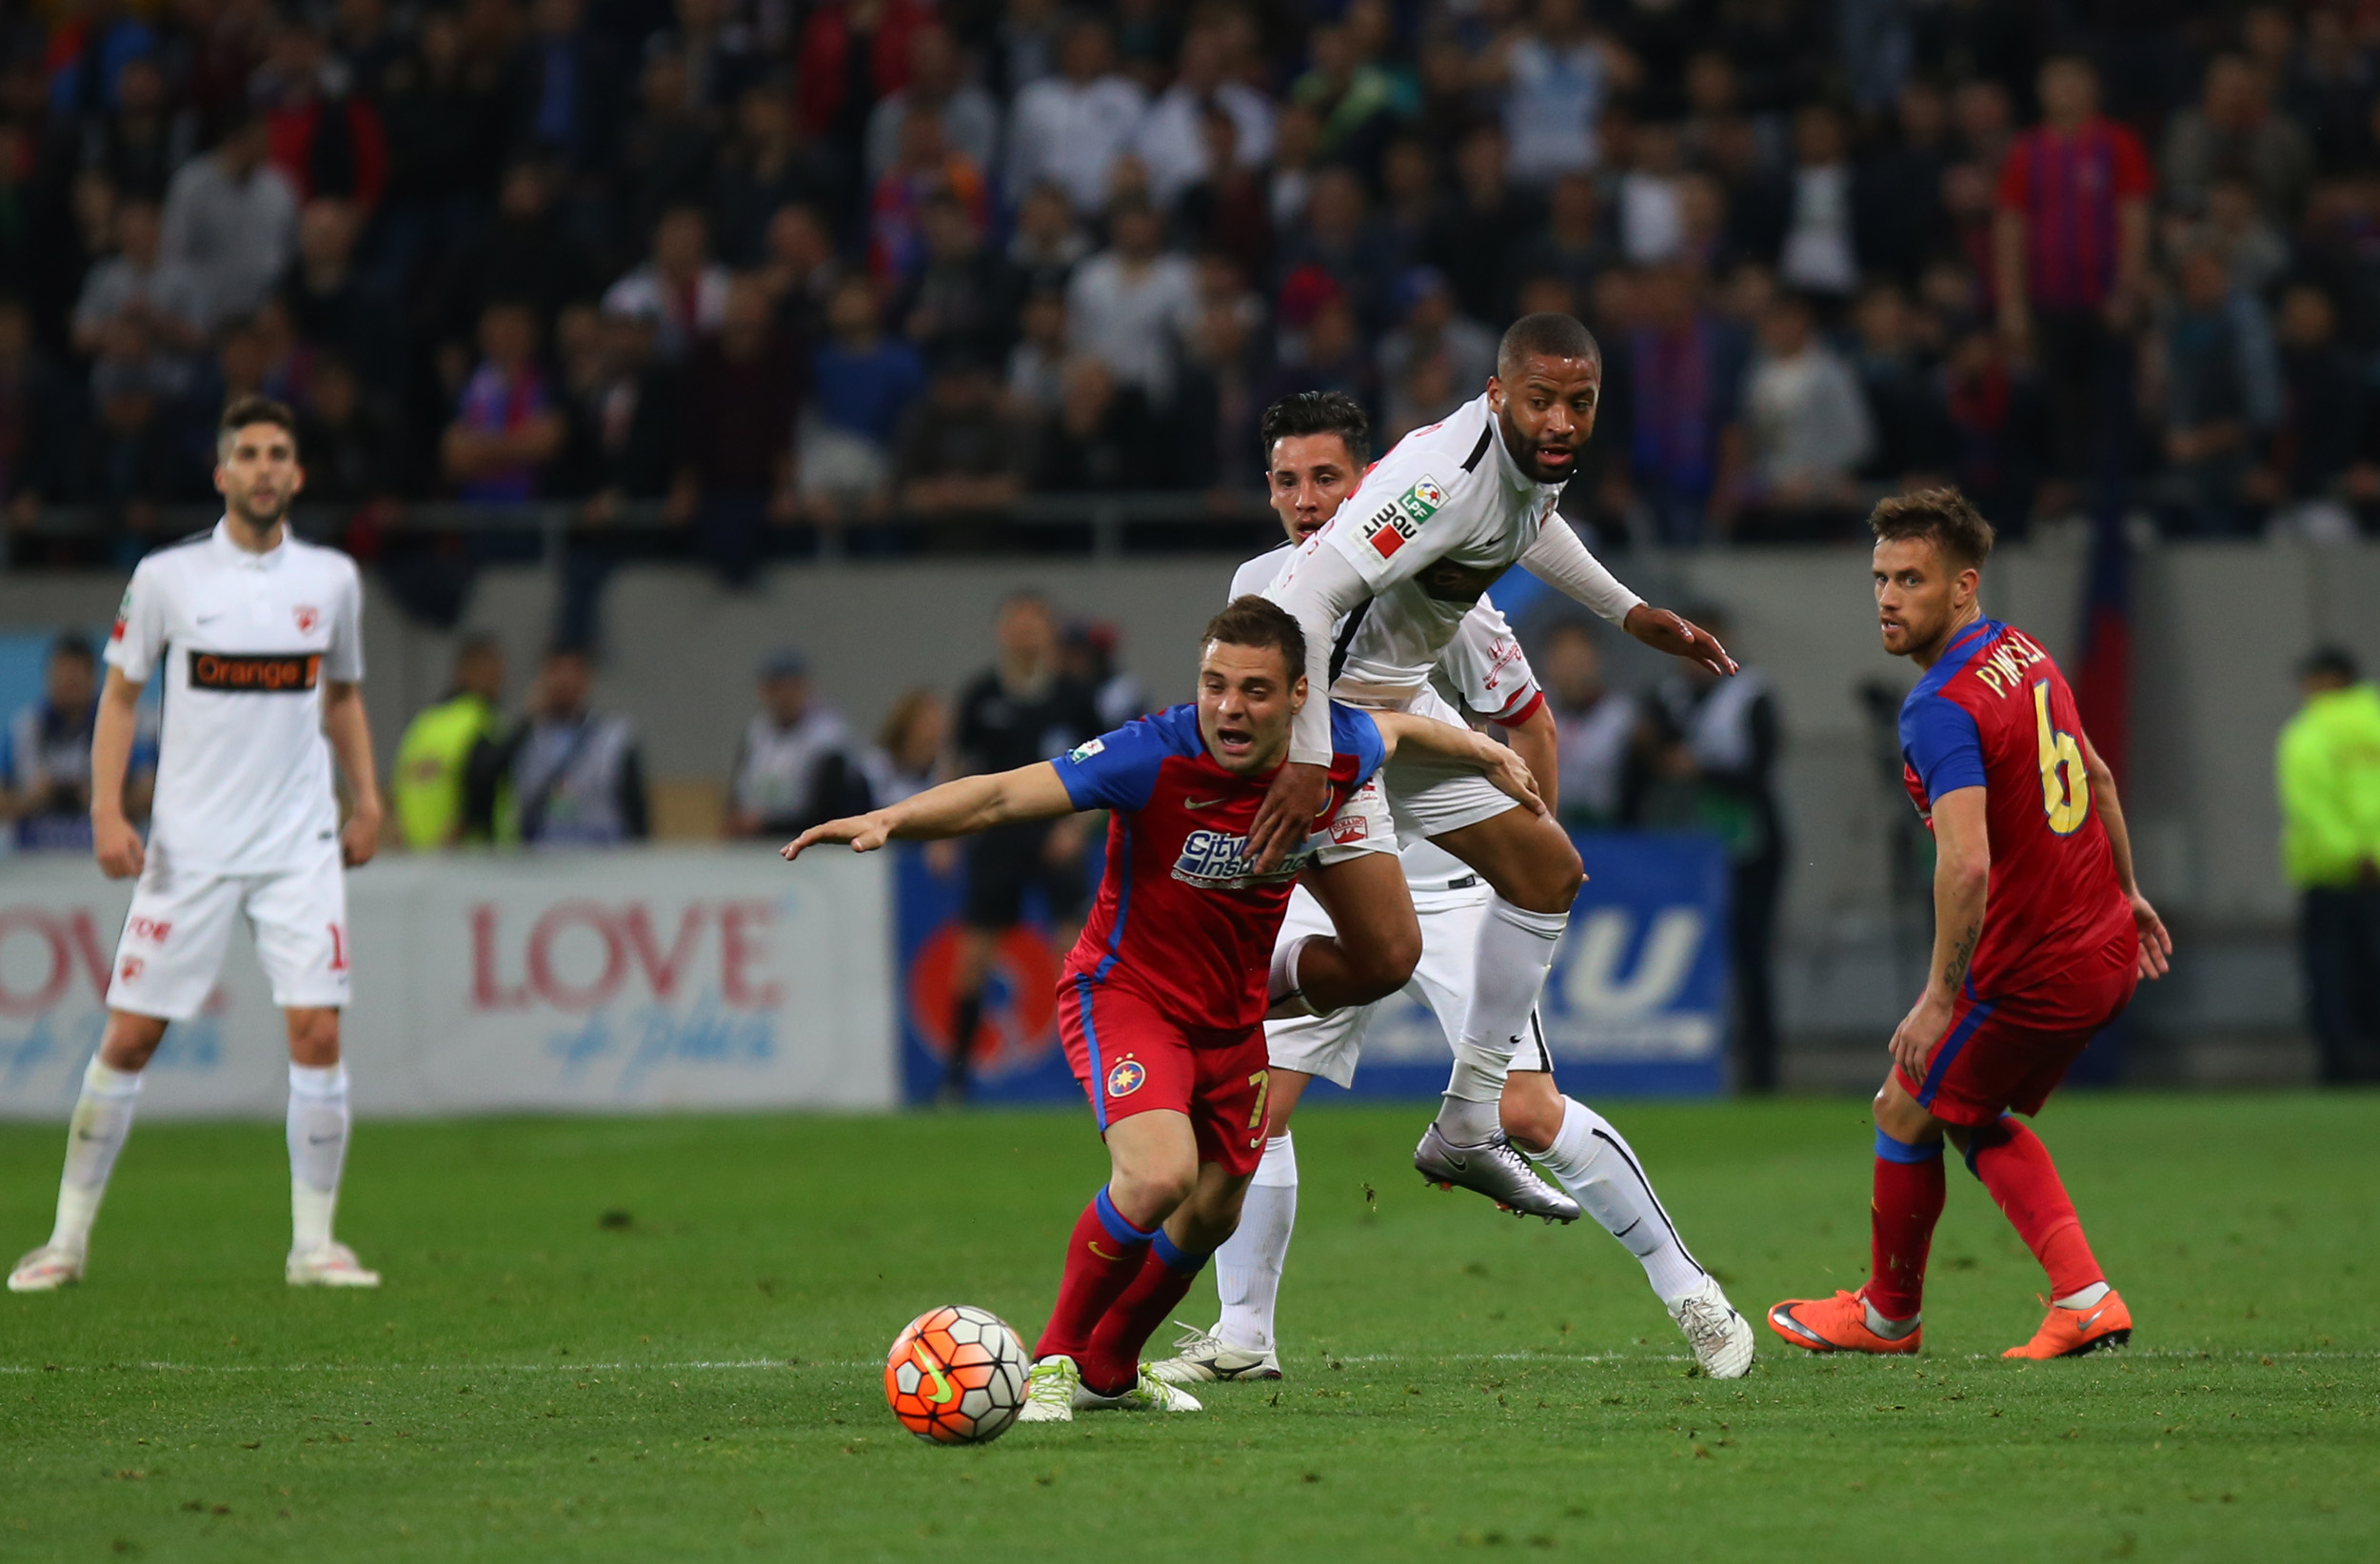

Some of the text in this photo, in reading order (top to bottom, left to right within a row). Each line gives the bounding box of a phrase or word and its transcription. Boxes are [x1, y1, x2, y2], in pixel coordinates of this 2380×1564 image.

[1401, 493, 1428, 518] LPF
[197, 653, 302, 689] Orange
[2033, 678, 2090, 837] 6
[1185, 833, 1243, 861] City
[466, 897, 788, 1015] LOVE
[1247, 1070, 1269, 1128] 7
